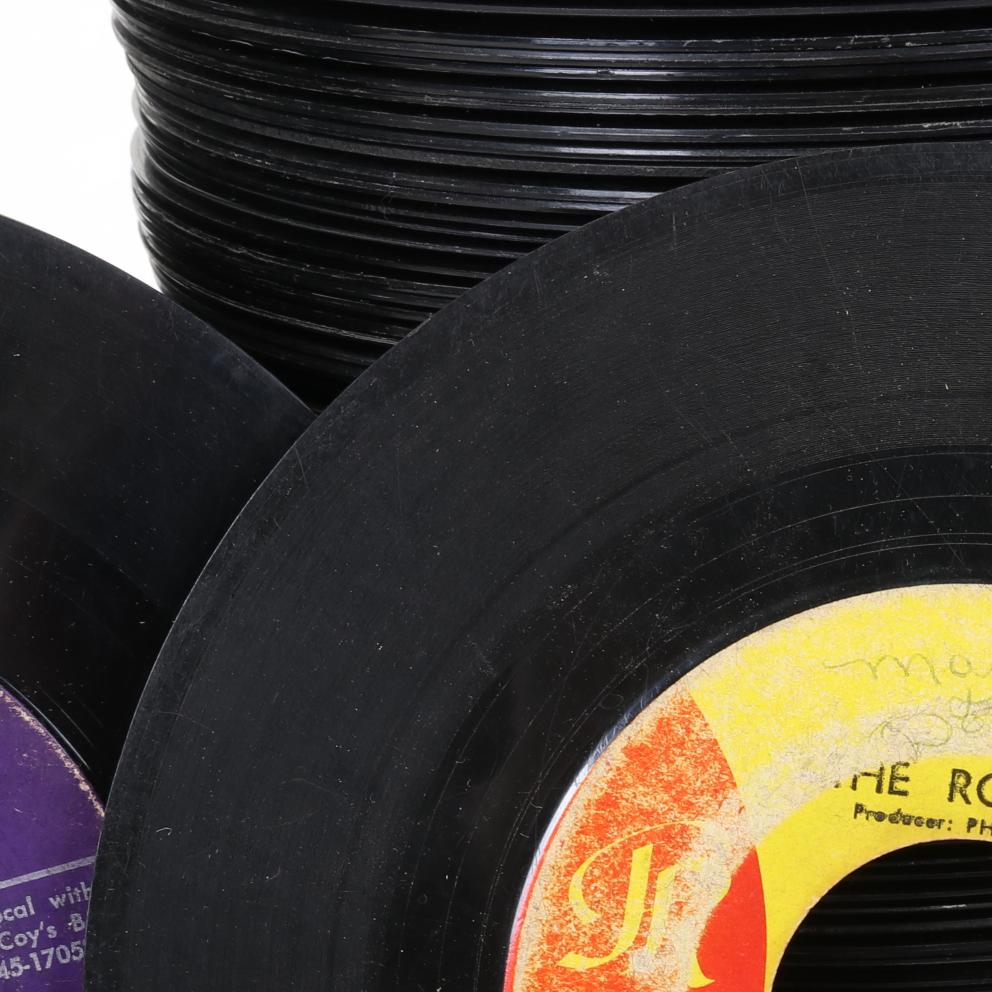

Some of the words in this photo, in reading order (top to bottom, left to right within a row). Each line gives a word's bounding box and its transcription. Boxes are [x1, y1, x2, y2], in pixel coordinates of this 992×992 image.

[834, 761, 910, 797] HE
[853, 803, 954, 833] Producer:
[0, 938, 87, 980] 45-1705
